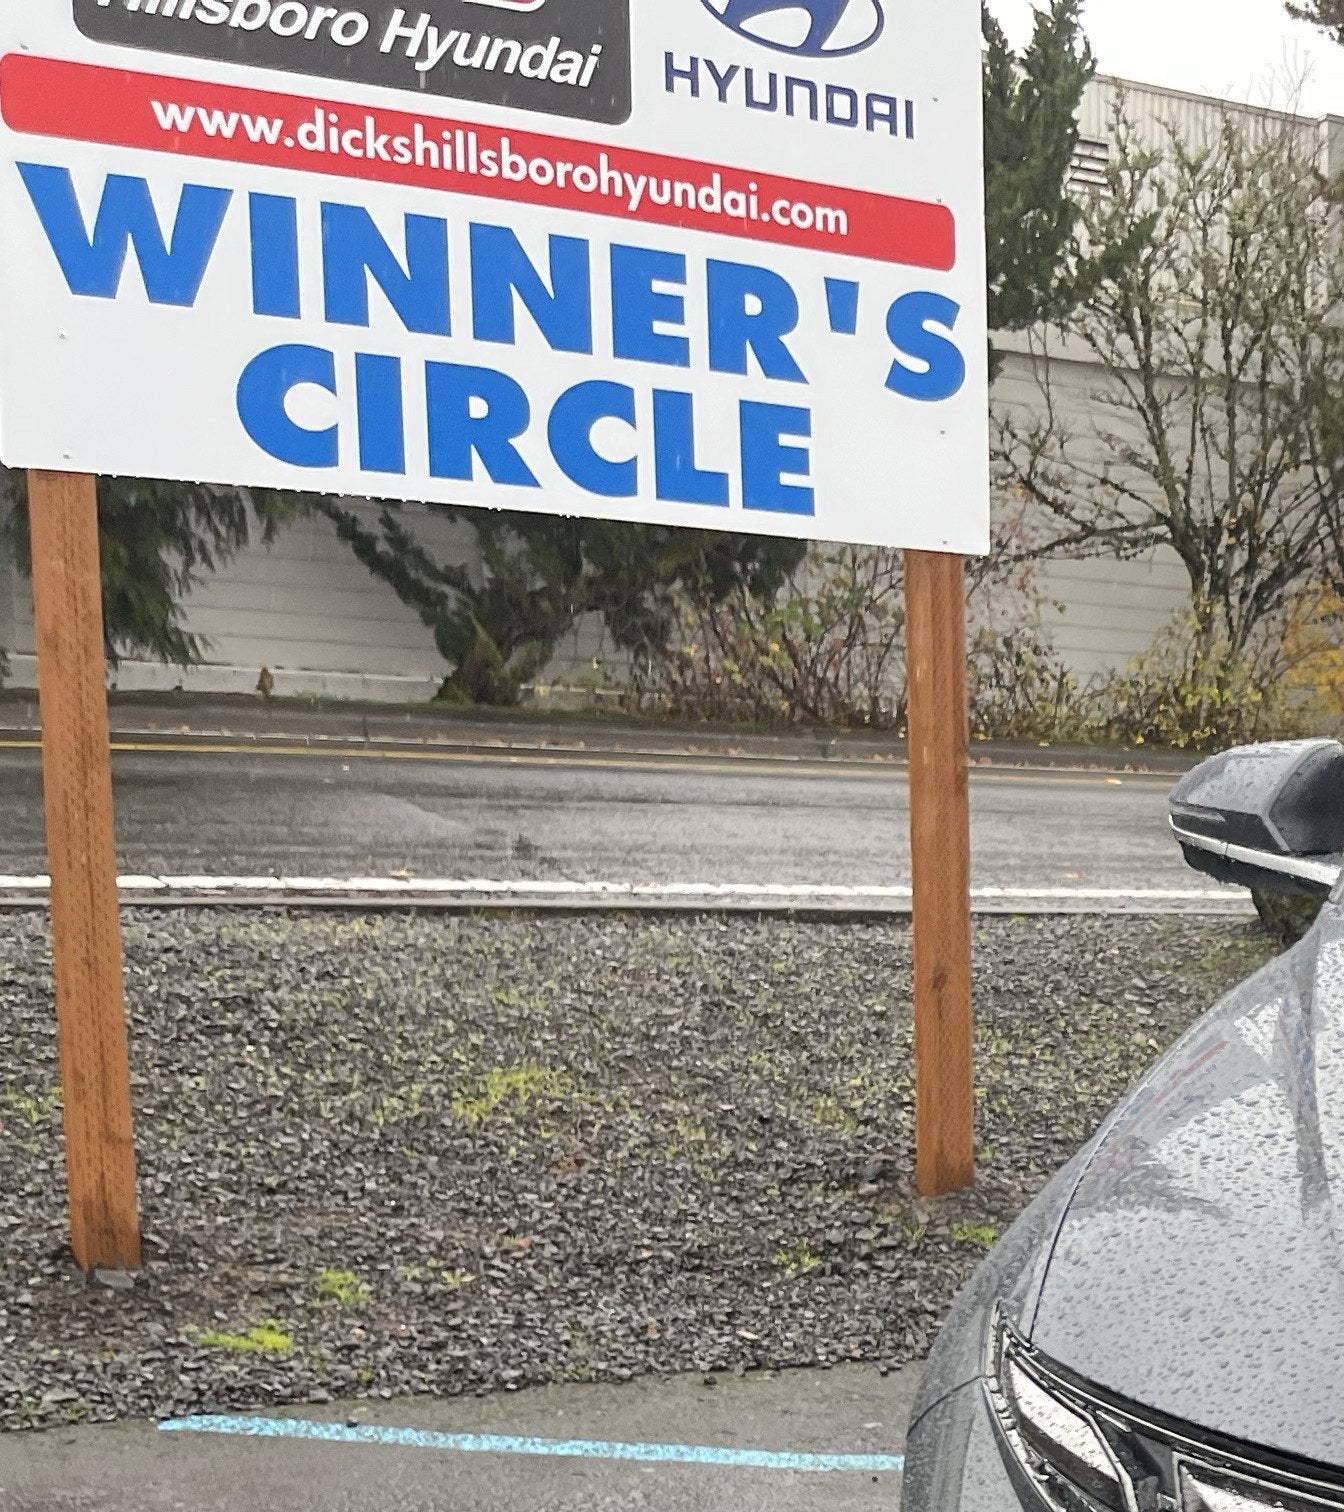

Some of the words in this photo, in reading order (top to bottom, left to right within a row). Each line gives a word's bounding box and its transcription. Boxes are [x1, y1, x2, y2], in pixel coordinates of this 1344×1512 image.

[97, 0, 369, 47] sboro
[381, 9, 603, 89] Hyundai
[664, 51, 915, 140] HYUNDAI
[151, 100, 848, 236] www.dickshillsborohyundai.com
[16, 161, 966, 402] WINNER'S
[236, 344, 815, 516] CIRCLE
